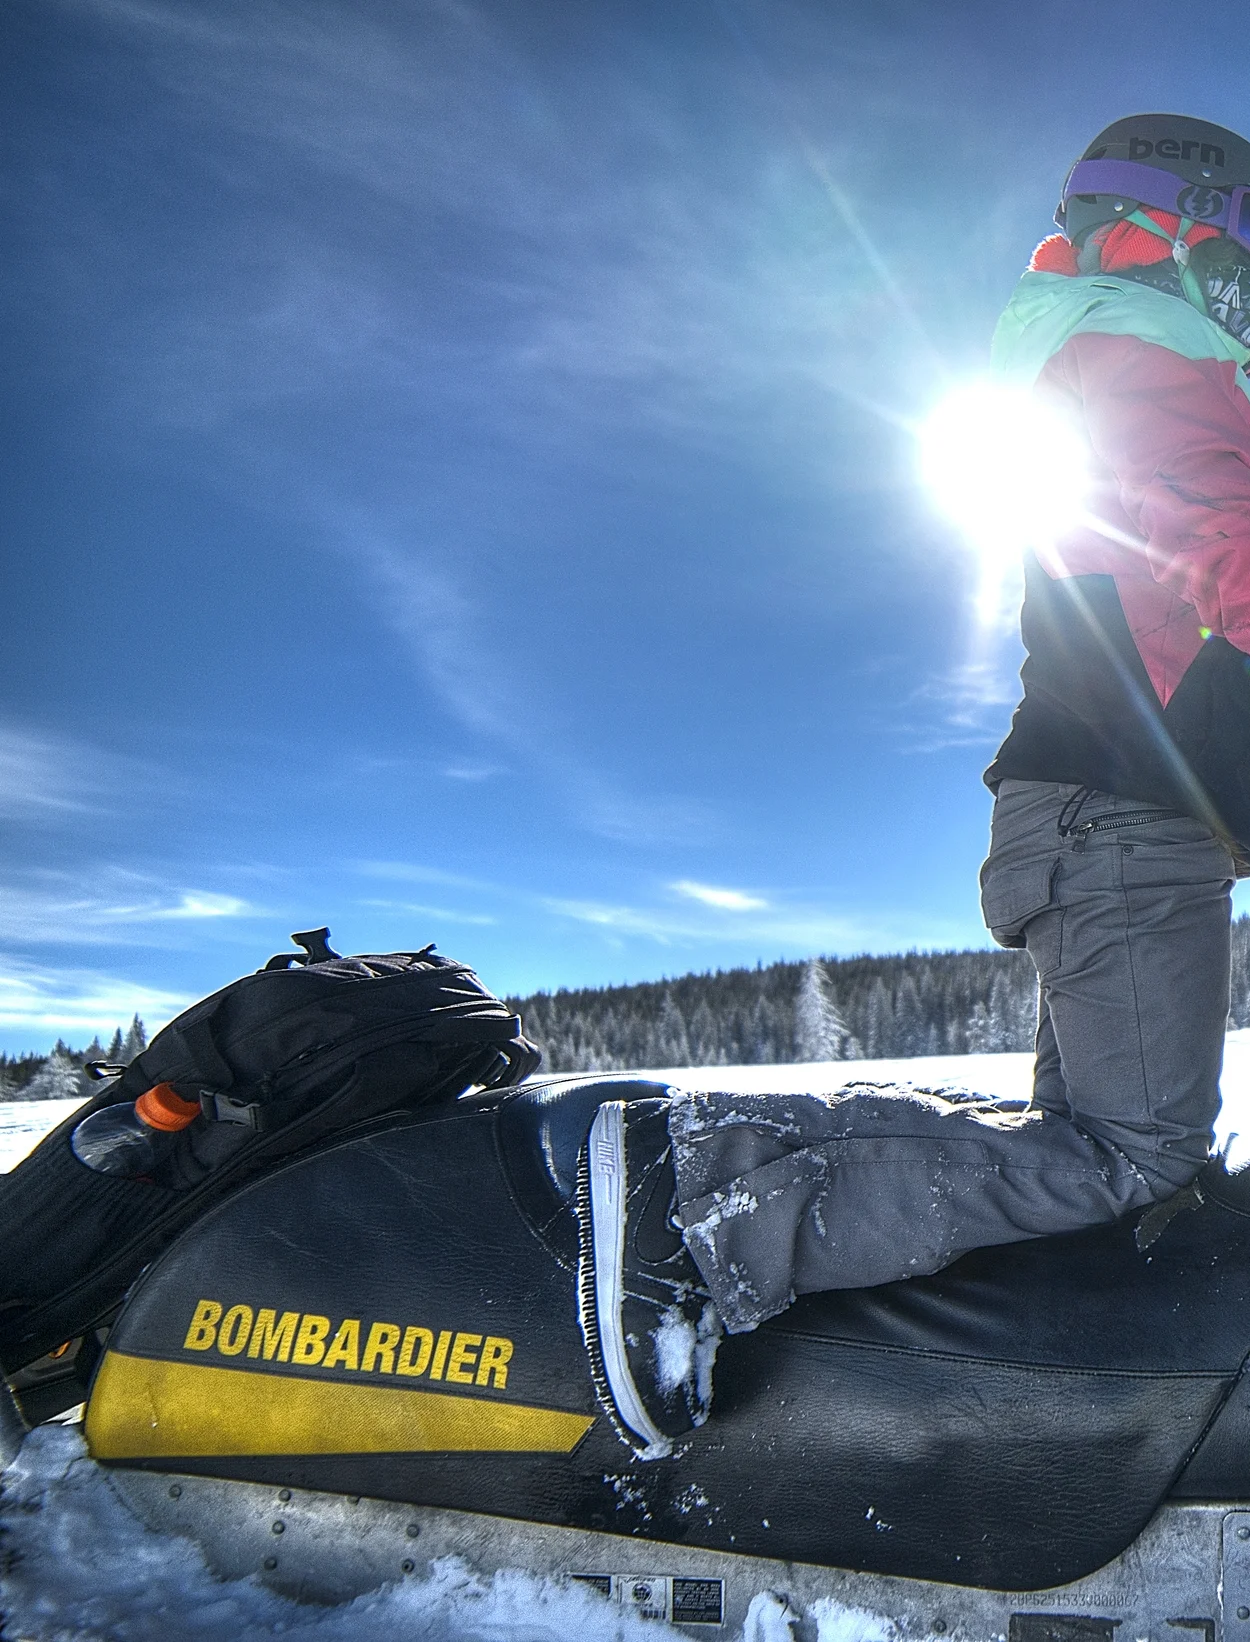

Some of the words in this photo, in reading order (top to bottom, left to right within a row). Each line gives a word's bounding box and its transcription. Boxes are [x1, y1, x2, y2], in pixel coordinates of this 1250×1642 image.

[1129, 137, 1225, 167] bern
[597, 1140, 615, 1173] NIKE
[183, 1299, 514, 1390] BOMBARDIER
